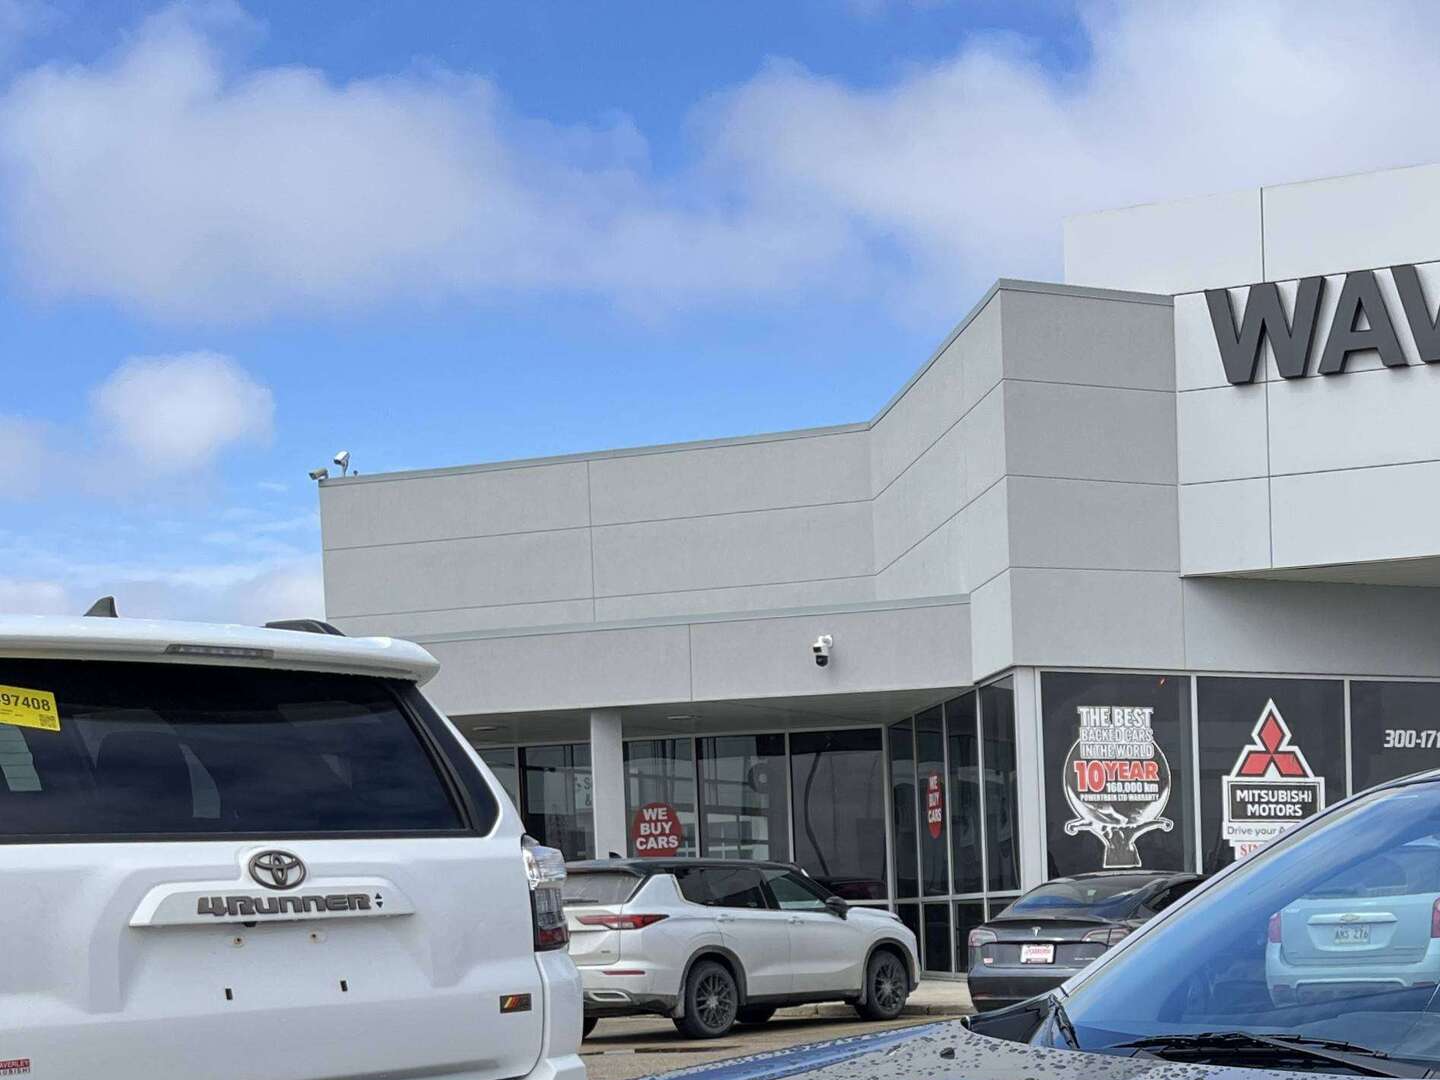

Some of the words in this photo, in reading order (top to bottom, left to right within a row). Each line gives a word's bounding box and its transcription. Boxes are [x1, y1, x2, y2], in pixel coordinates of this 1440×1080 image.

[1078, 706, 1110, 727] THE
[1111, 706, 1154, 727] BEST
[1080, 728, 1122, 741] BACKED
[1123, 728, 1154, 741] CARS
[1081, 743, 1094, 758] IN
[1095, 743, 1115, 758] THE
[1116, 743, 1155, 758] WORLD
[1074, 760, 1106, 792] 10
[1104, 760, 1160, 781] YEAR
[1106, 782, 1143, 793] 160,000
[1144, 782, 1159, 793] km
[1235, 789, 1313, 802] MITSUBISHI
[643, 808, 668, 821] WE
[1246, 803, 1303, 816] MOTORS
[639, 821, 673, 835] BUY
[1227, 826, 1253, 835] Drive
[1254, 828, 1277, 838] your
[636, 835, 679, 850] CARS
